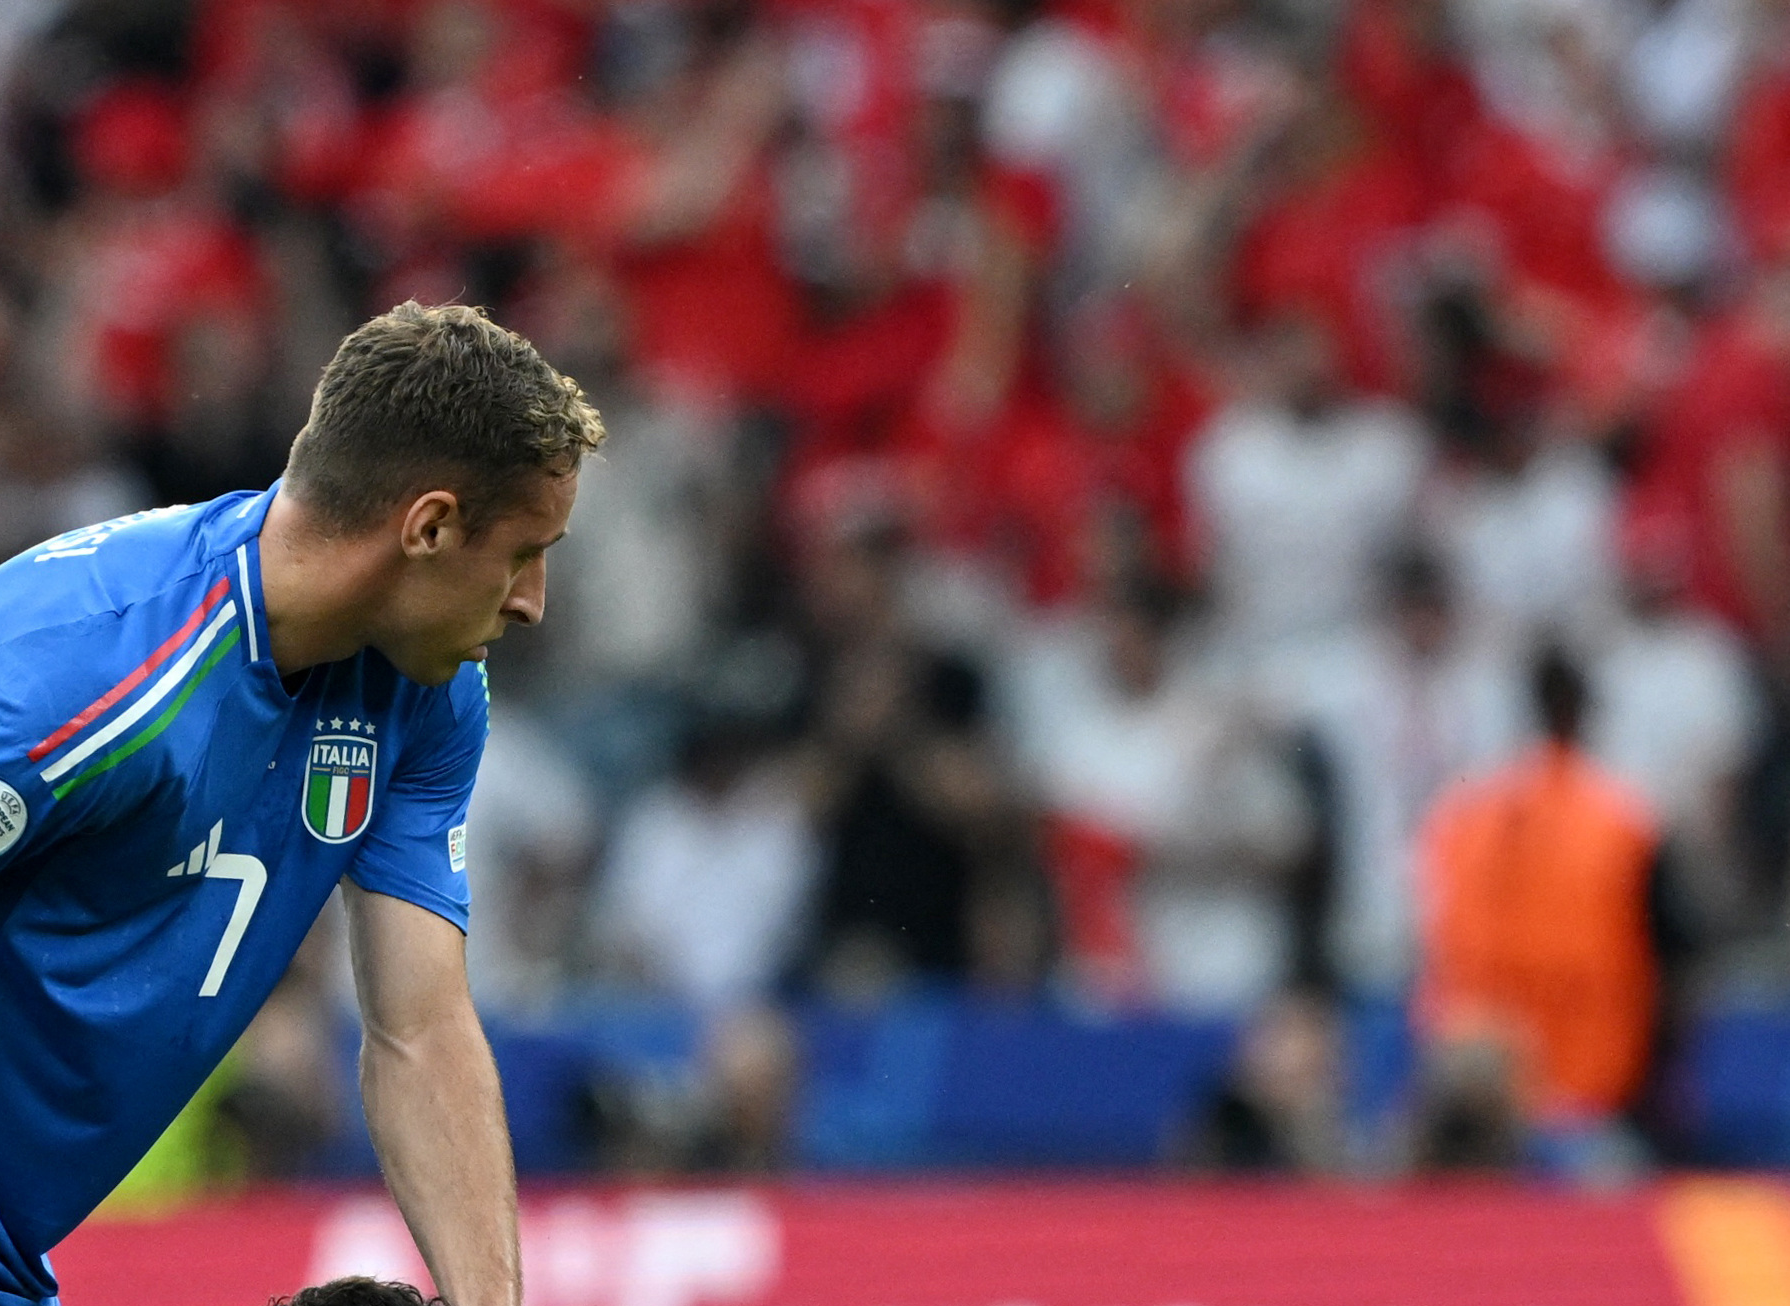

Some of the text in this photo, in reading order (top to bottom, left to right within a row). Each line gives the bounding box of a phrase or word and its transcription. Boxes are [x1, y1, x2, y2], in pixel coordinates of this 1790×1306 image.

[312, 744, 370, 767] ITALIA
[1, 792, 19, 815] UEFA
[198, 853, 268, 998] 7
